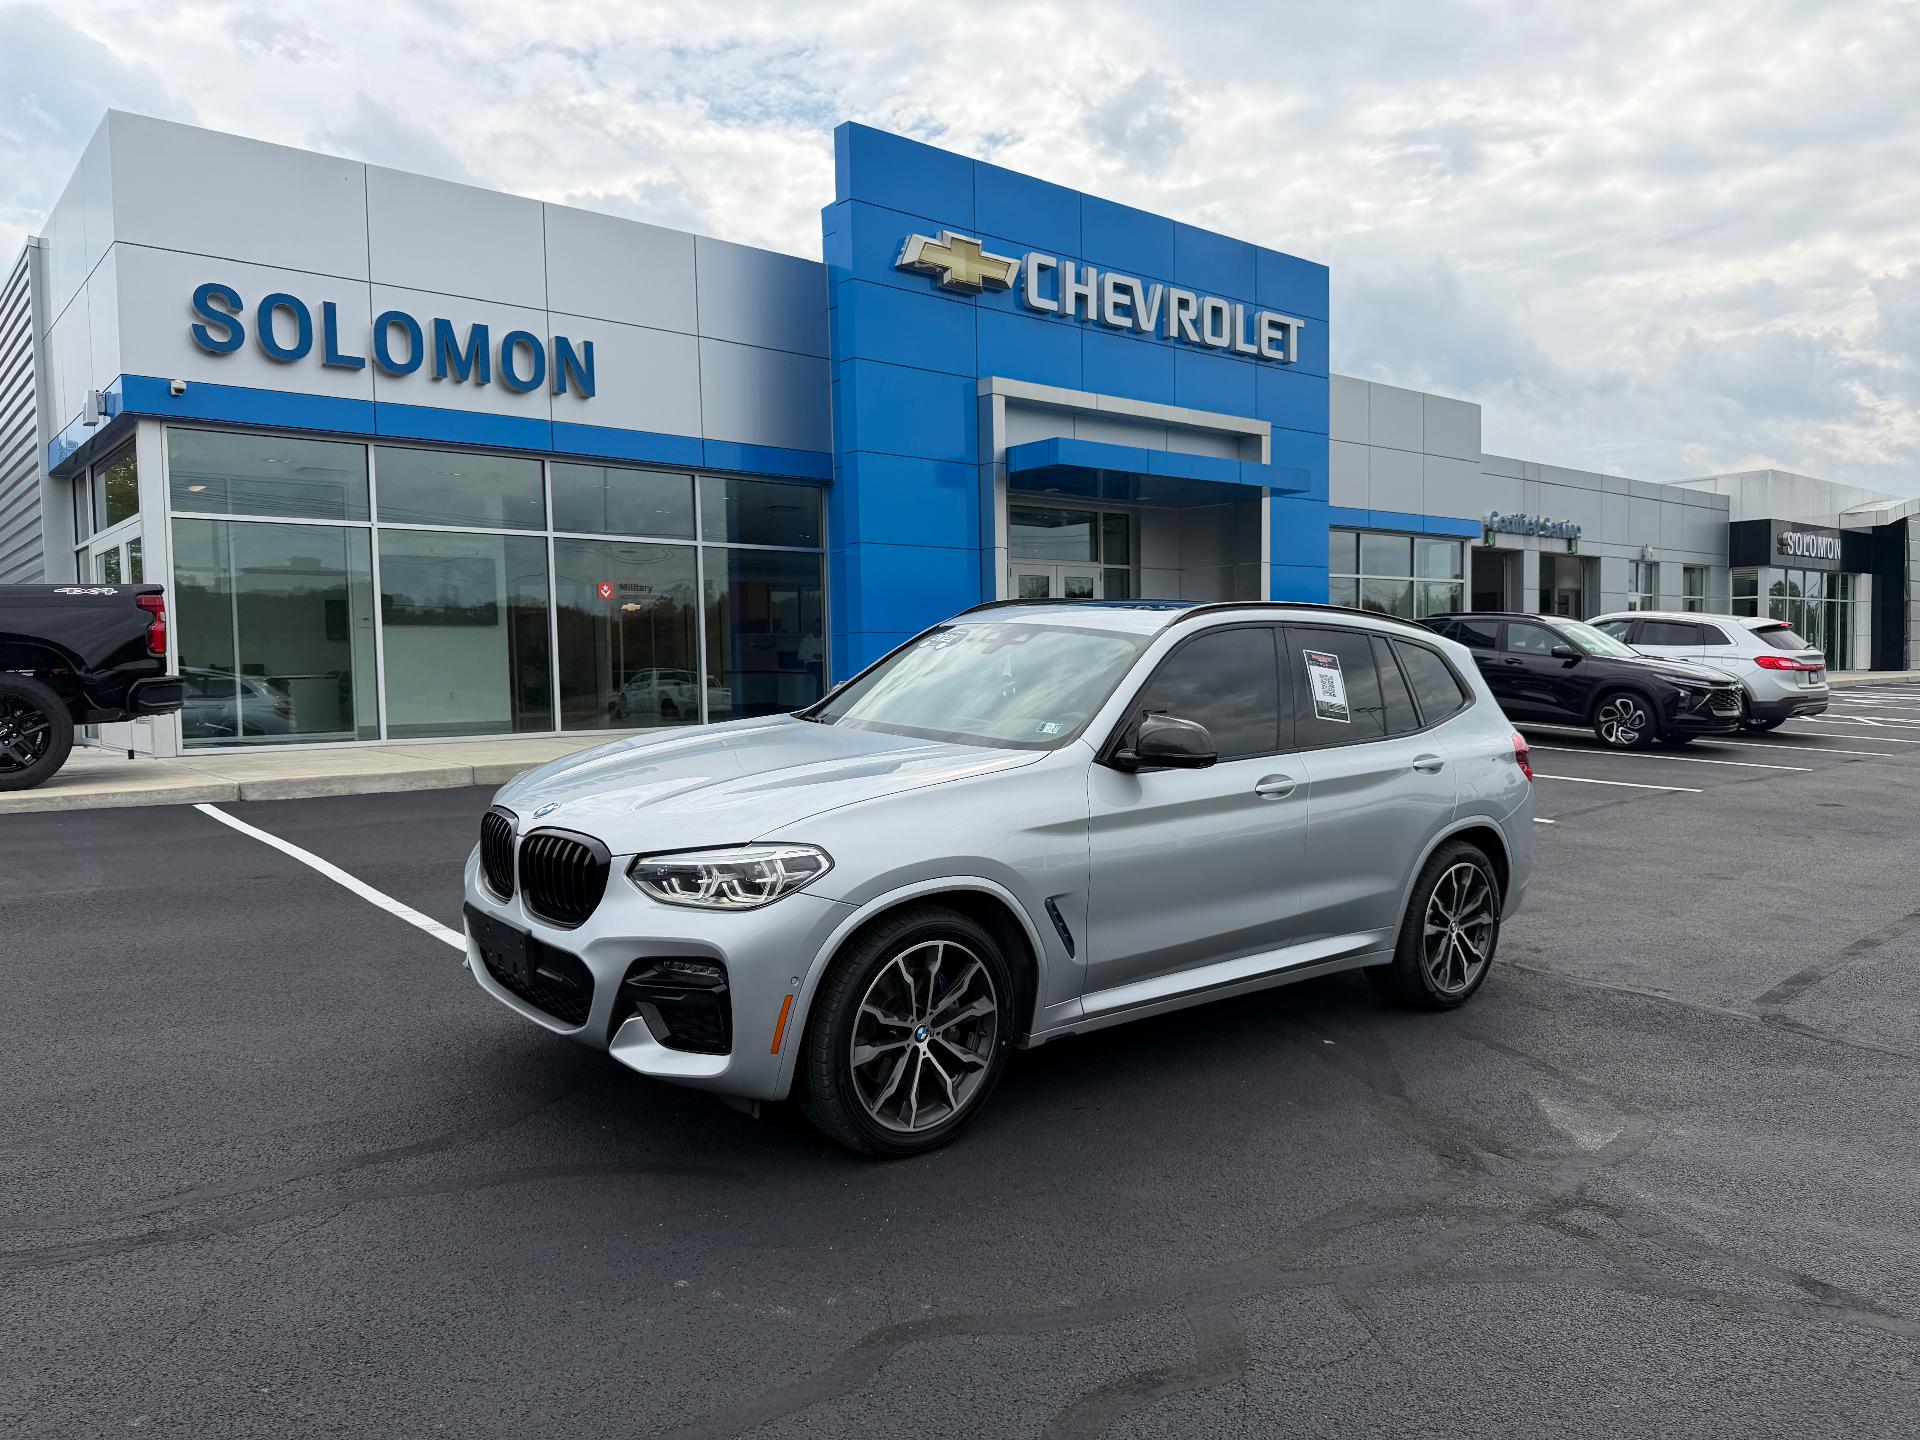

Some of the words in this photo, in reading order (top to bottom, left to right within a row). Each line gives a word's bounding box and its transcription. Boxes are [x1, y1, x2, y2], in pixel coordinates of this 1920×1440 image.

[190, 282, 596, 399] SOLOMON
[1021, 252, 1305, 364] CHEVROLET
[1780, 531, 1841, 560] SOLOMON
[619, 583, 654, 594] Military
